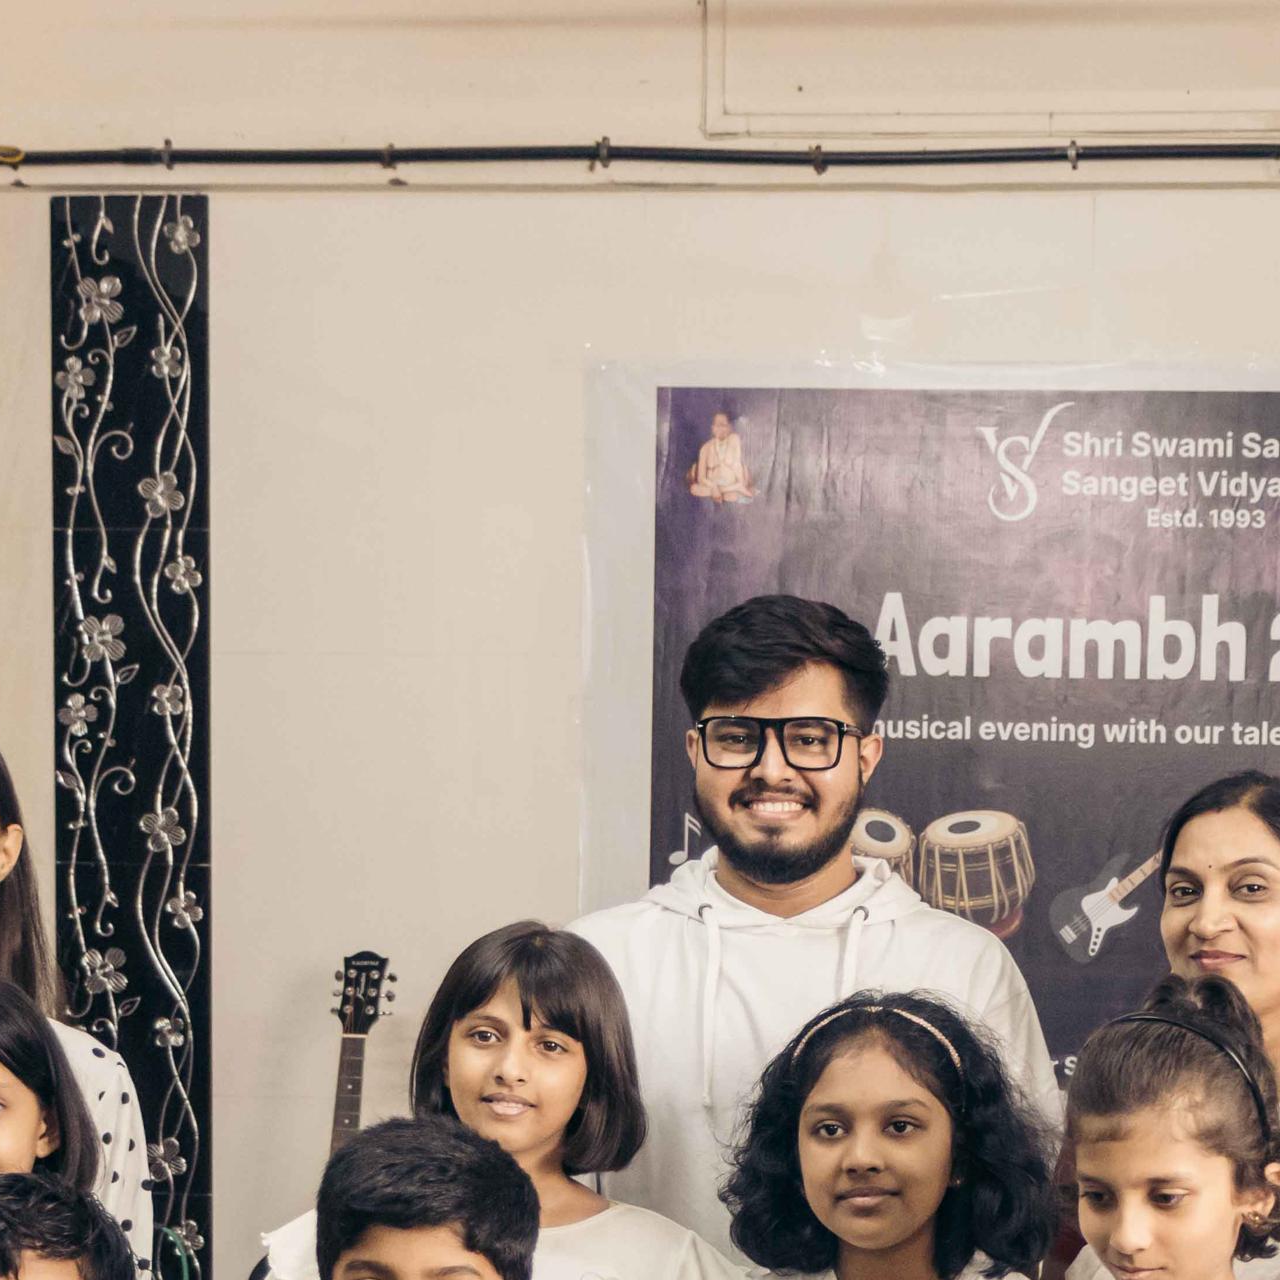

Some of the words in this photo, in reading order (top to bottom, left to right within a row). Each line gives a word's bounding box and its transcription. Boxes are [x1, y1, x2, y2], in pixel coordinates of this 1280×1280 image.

[1063, 431, 1123, 458] Shri
[1131, 431, 1234, 459] Swami
[1061, 470, 1189, 502] Sangeet
[1146, 508, 1204, 529] Estd.
[1208, 509, 1267, 529] 1993
[874, 591, 1247, 682] Aarambh
[978, 716, 1095, 749] evening
[1103, 718, 1167, 744] with
[1174, 723, 1225, 745] our
